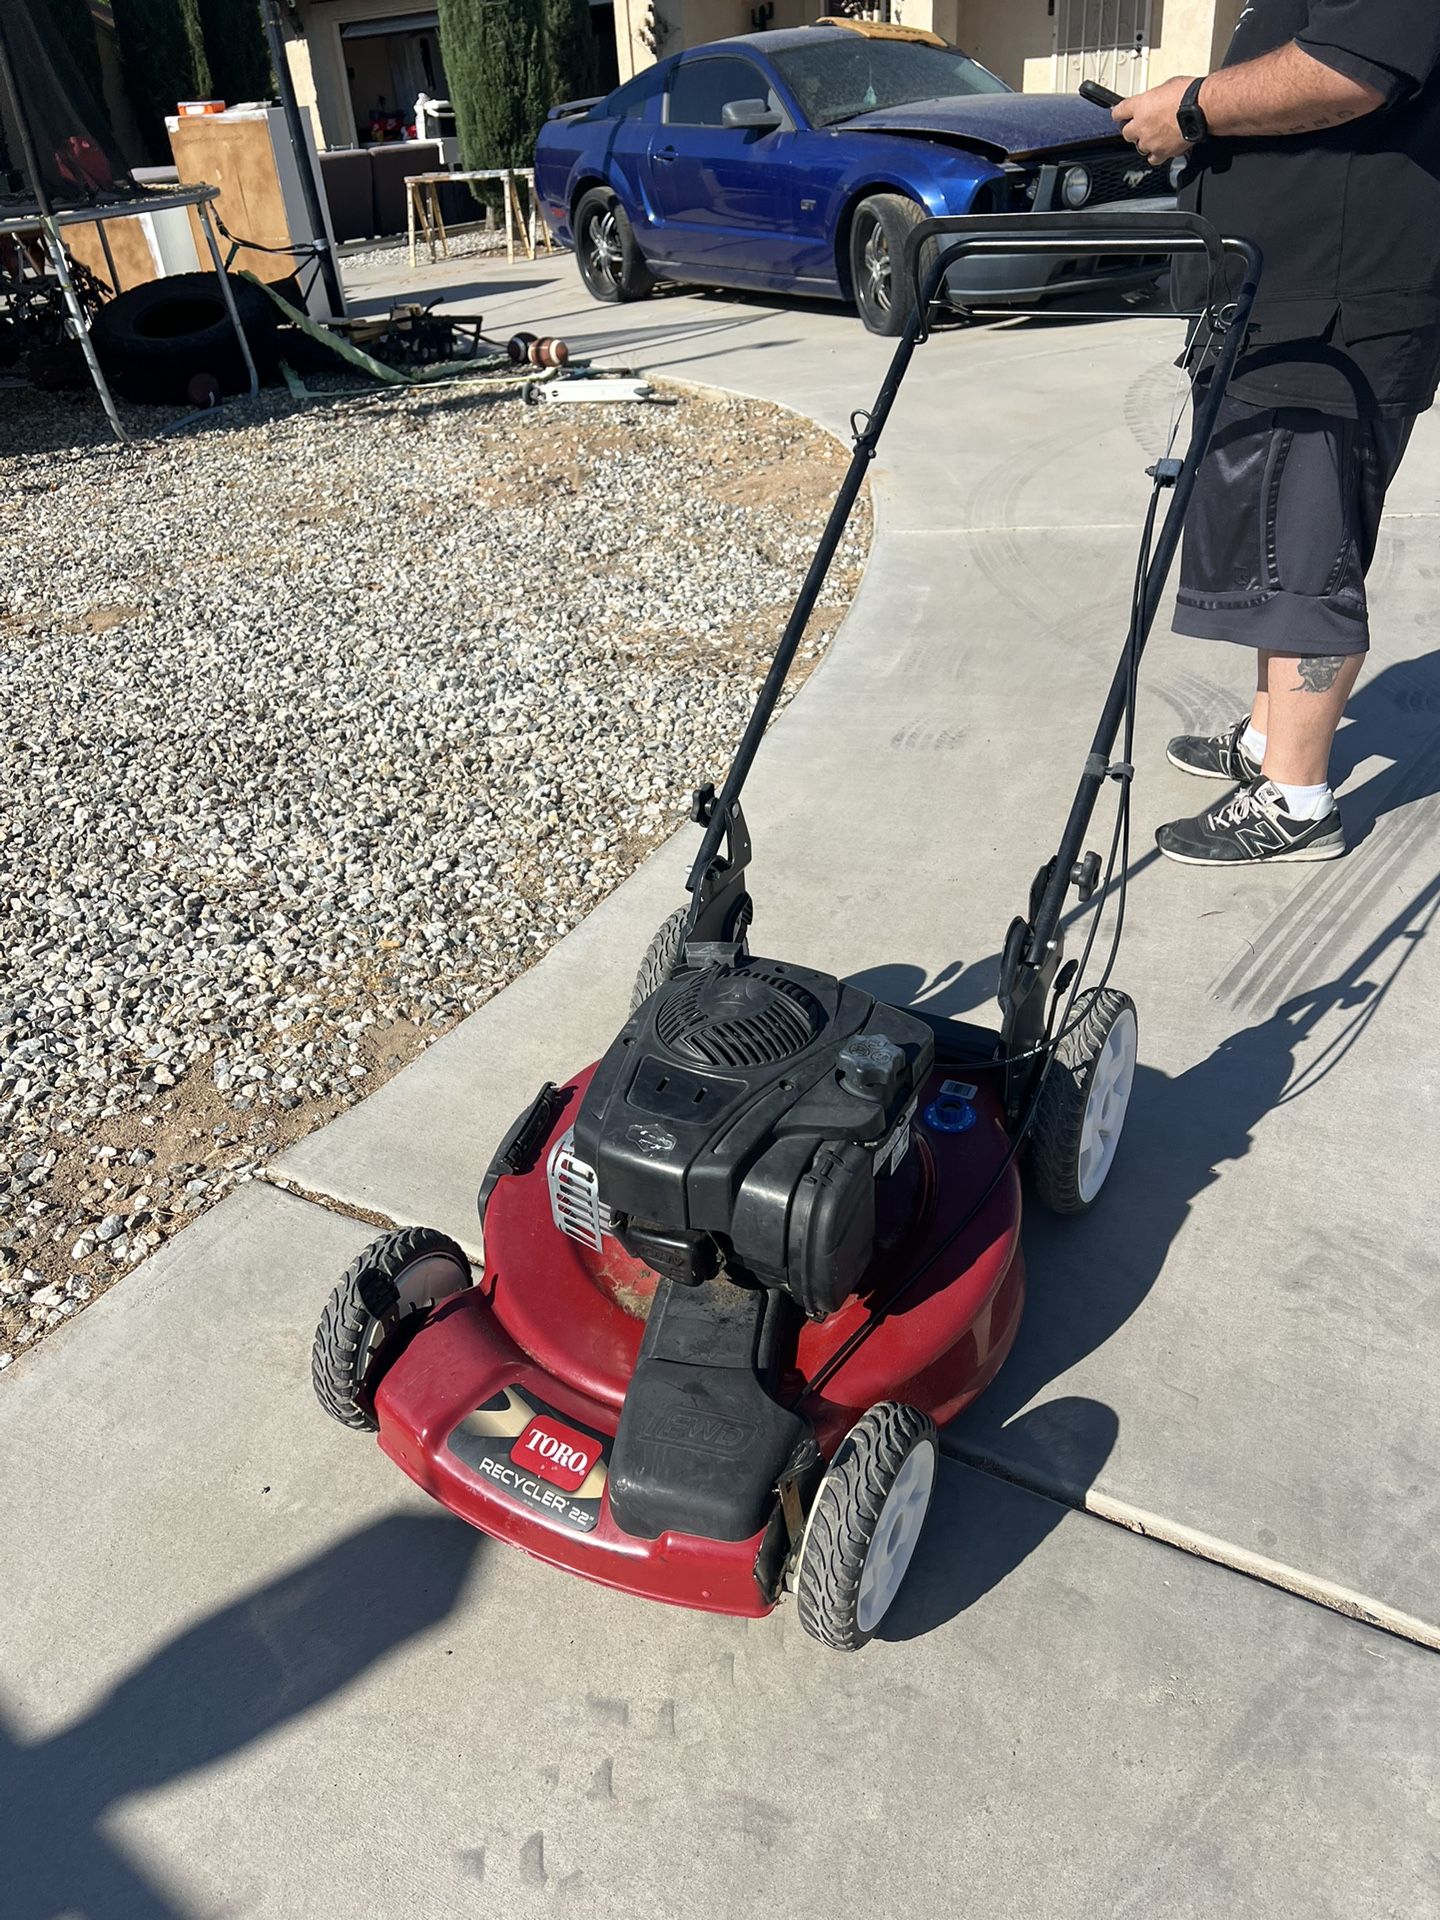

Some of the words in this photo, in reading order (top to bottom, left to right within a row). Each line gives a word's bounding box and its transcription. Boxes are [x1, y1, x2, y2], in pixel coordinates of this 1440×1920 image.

[1235, 820, 1286, 858] N
[525, 1428, 589, 1474] TORO
[479, 1457, 566, 1513] RECYCLER
